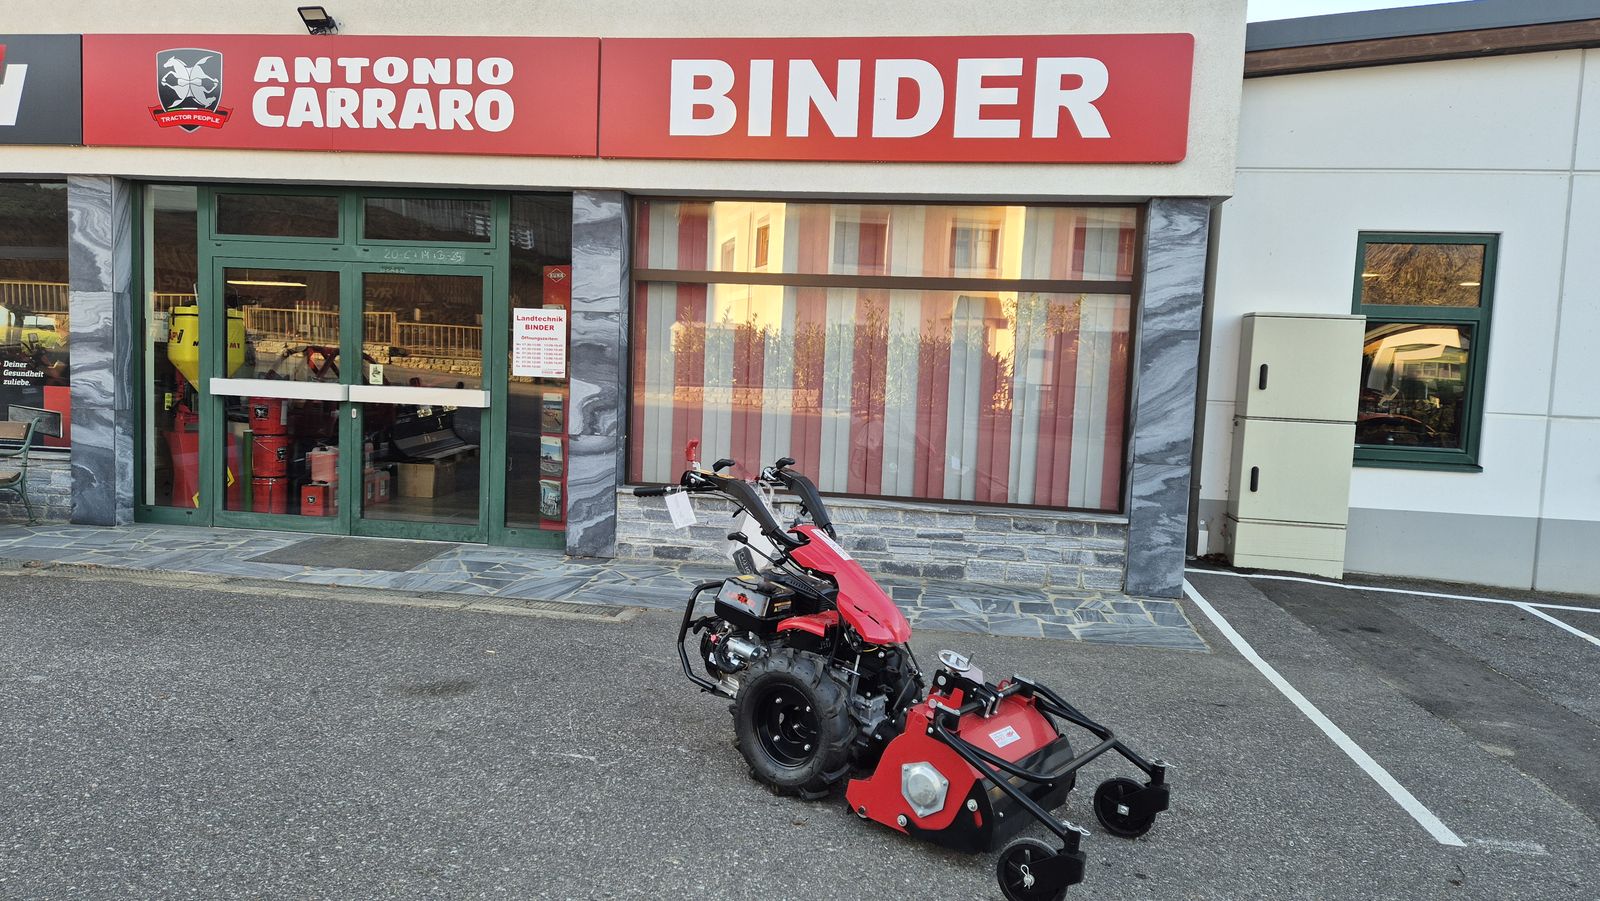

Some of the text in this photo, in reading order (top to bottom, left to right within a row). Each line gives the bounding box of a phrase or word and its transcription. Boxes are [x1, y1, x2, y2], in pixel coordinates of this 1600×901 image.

[254, 56, 514, 85] ANTONIO
[669, 57, 1111, 138] BINDER
[252, 86, 515, 132] CARRARO
[160, 114, 220, 124] TRACTOR PEOPLE
[3, 360, 28, 368] Deiner
[3, 369, 44, 378] Gesundheit
[3, 378, 31, 386] zuliebe.
